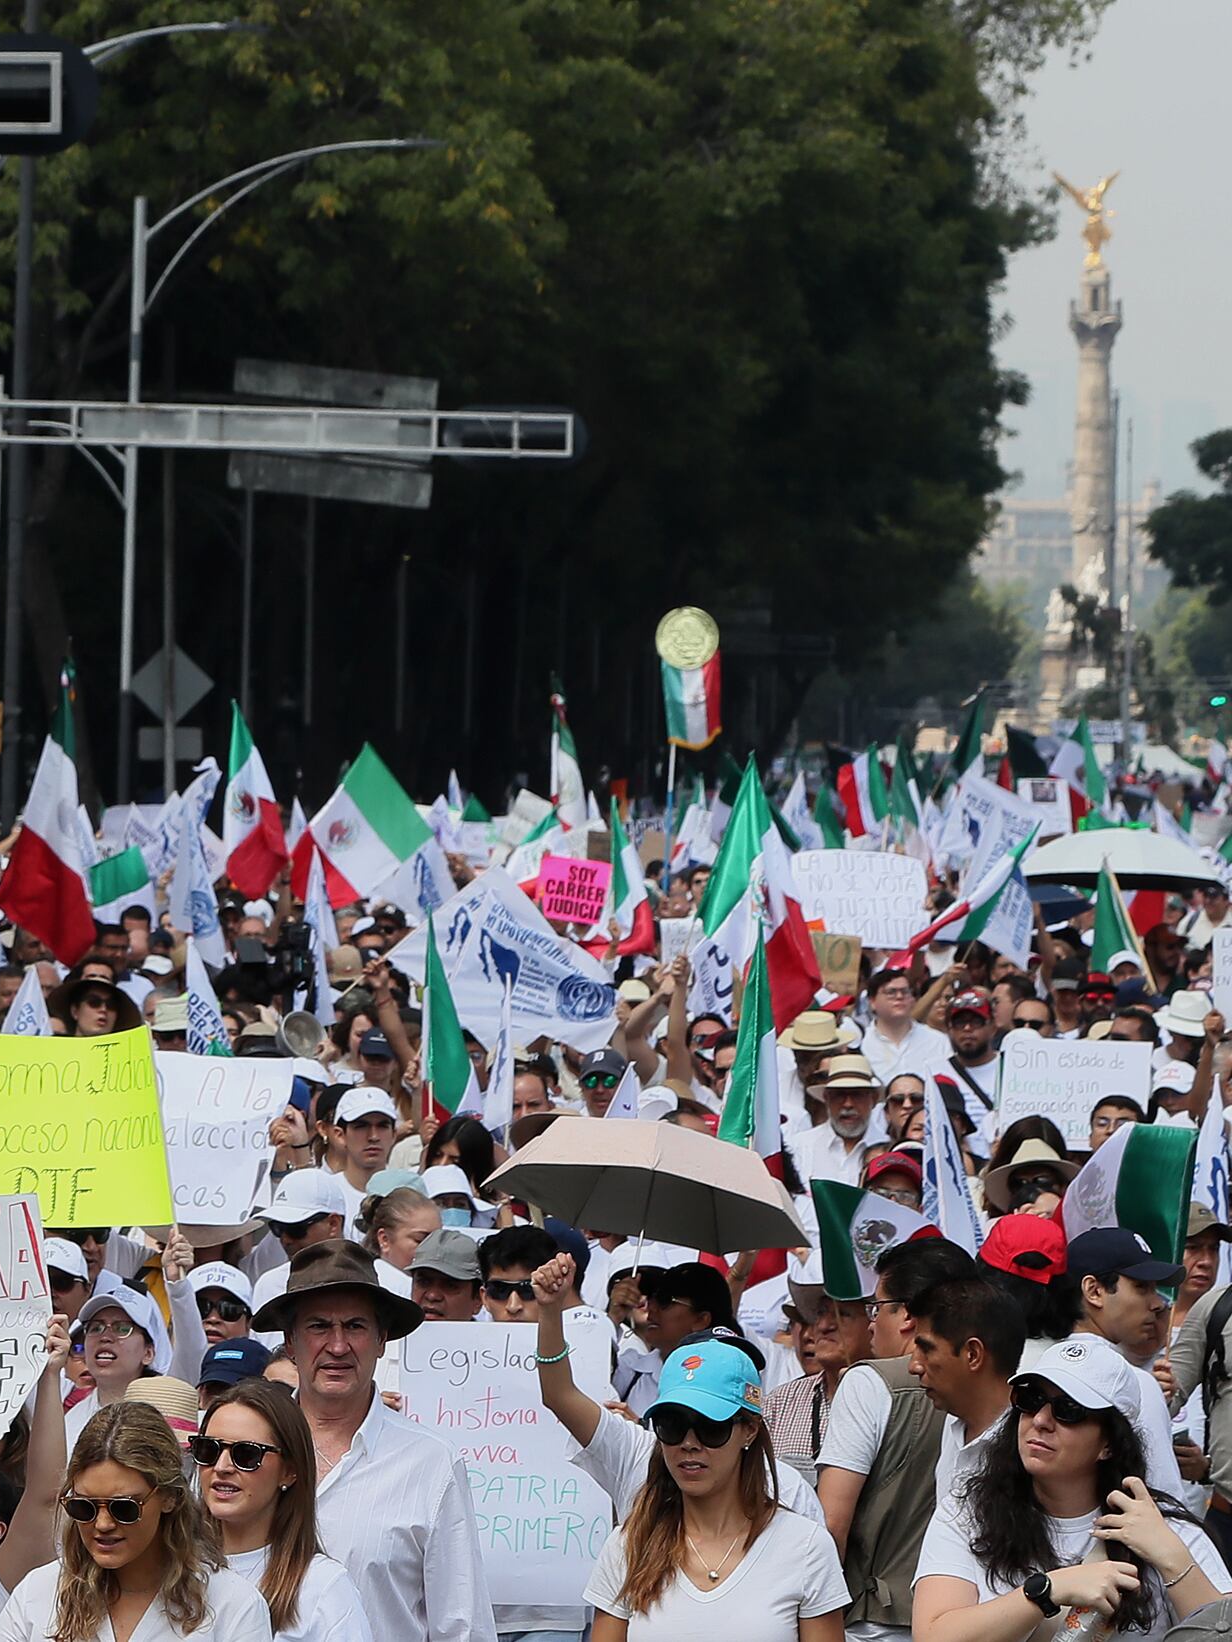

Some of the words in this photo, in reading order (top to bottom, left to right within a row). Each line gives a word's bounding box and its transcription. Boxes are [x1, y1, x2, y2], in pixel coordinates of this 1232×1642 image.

[568, 865, 598, 883] SOY
[1011, 1041, 1049, 1069] Sin
[1057, 1051, 1105, 1069] estado
[1007, 1072, 1062, 1095] derecho
[1077, 1080, 1101, 1094] sin
[436, 1386, 538, 1431] historia
[467, 1469, 580, 1508] PATRIA
[477, 1511, 609, 1560] PRIMERO
